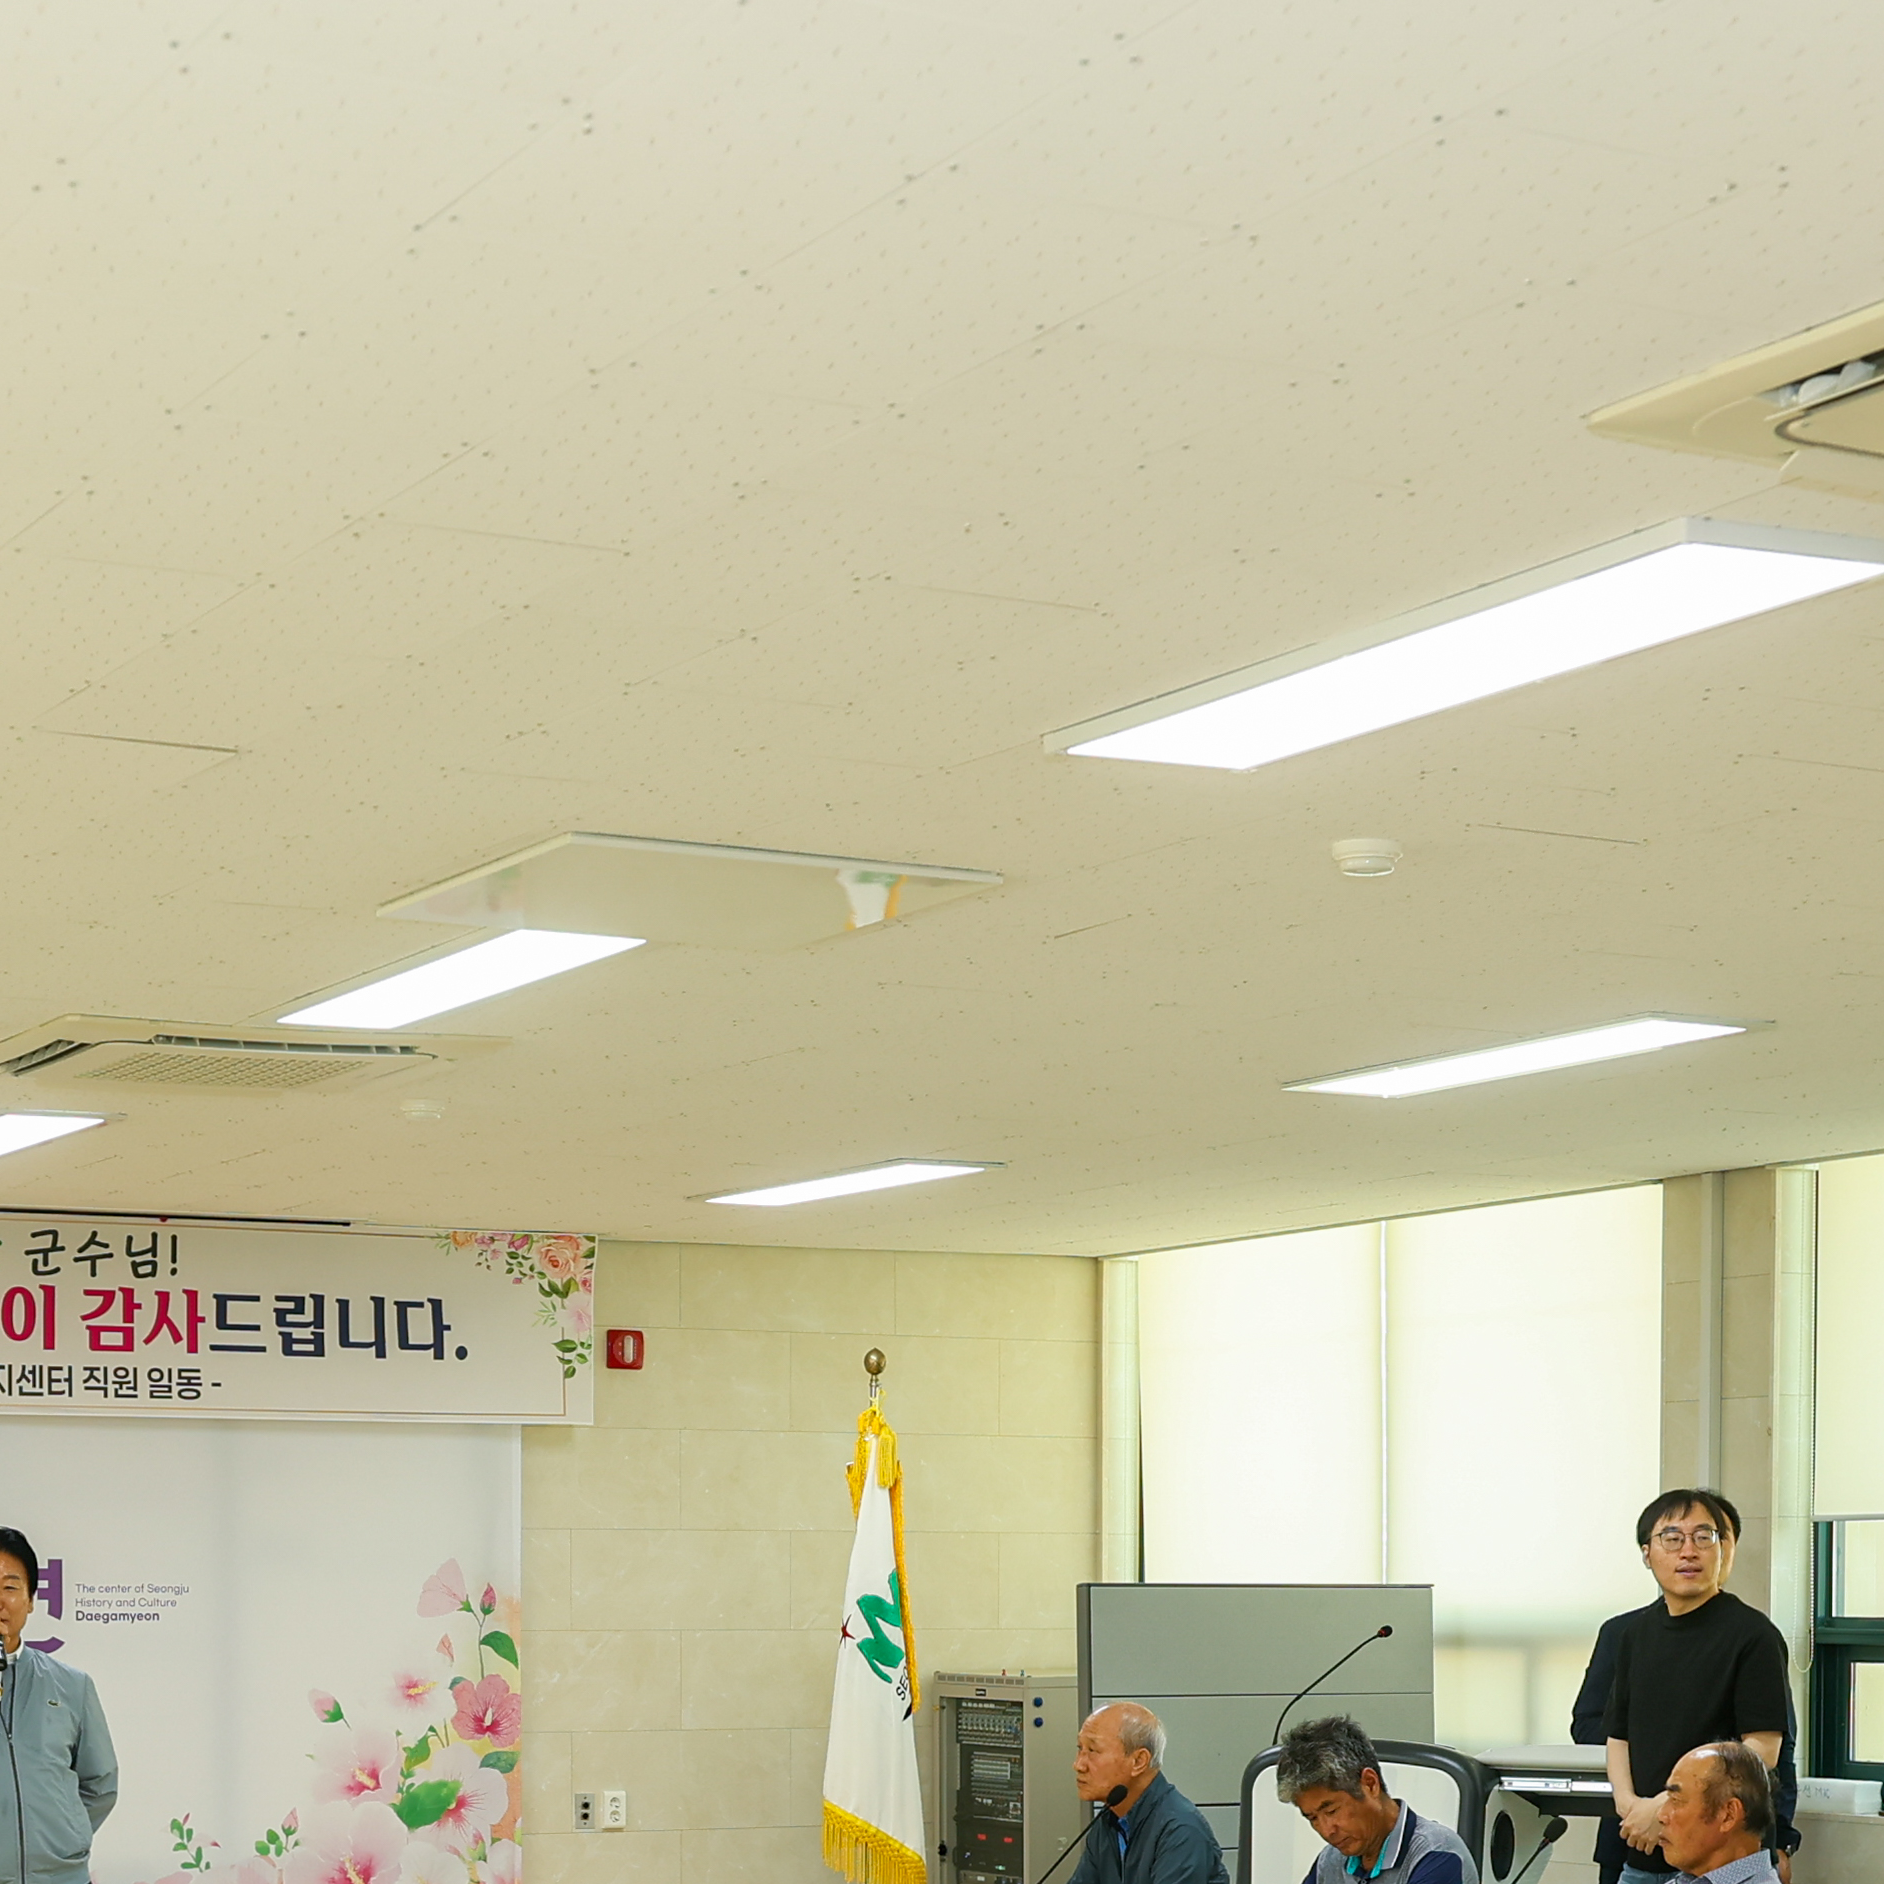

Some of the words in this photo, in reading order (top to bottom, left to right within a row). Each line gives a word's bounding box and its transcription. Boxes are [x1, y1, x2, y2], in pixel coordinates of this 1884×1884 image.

[23, 1230, 181, 1279] 군수님!
[81, 1286, 469, 1362] 감사드립니다.
[83, 1364, 139, 1399] 직원
[146, 1367, 203, 1401] 일동
[75, 1583, 96, 1594] The
[98, 1584, 132, 1594] center
[135, 1583, 145, 1594] of
[147, 1583, 190, 1596] Seongju
[75, 1597, 113, 1609] History
[115, 1597, 136, 1608] and
[138, 1597, 177, 1608] Culture
[75, 1610, 161, 1624] Daegamyeon
